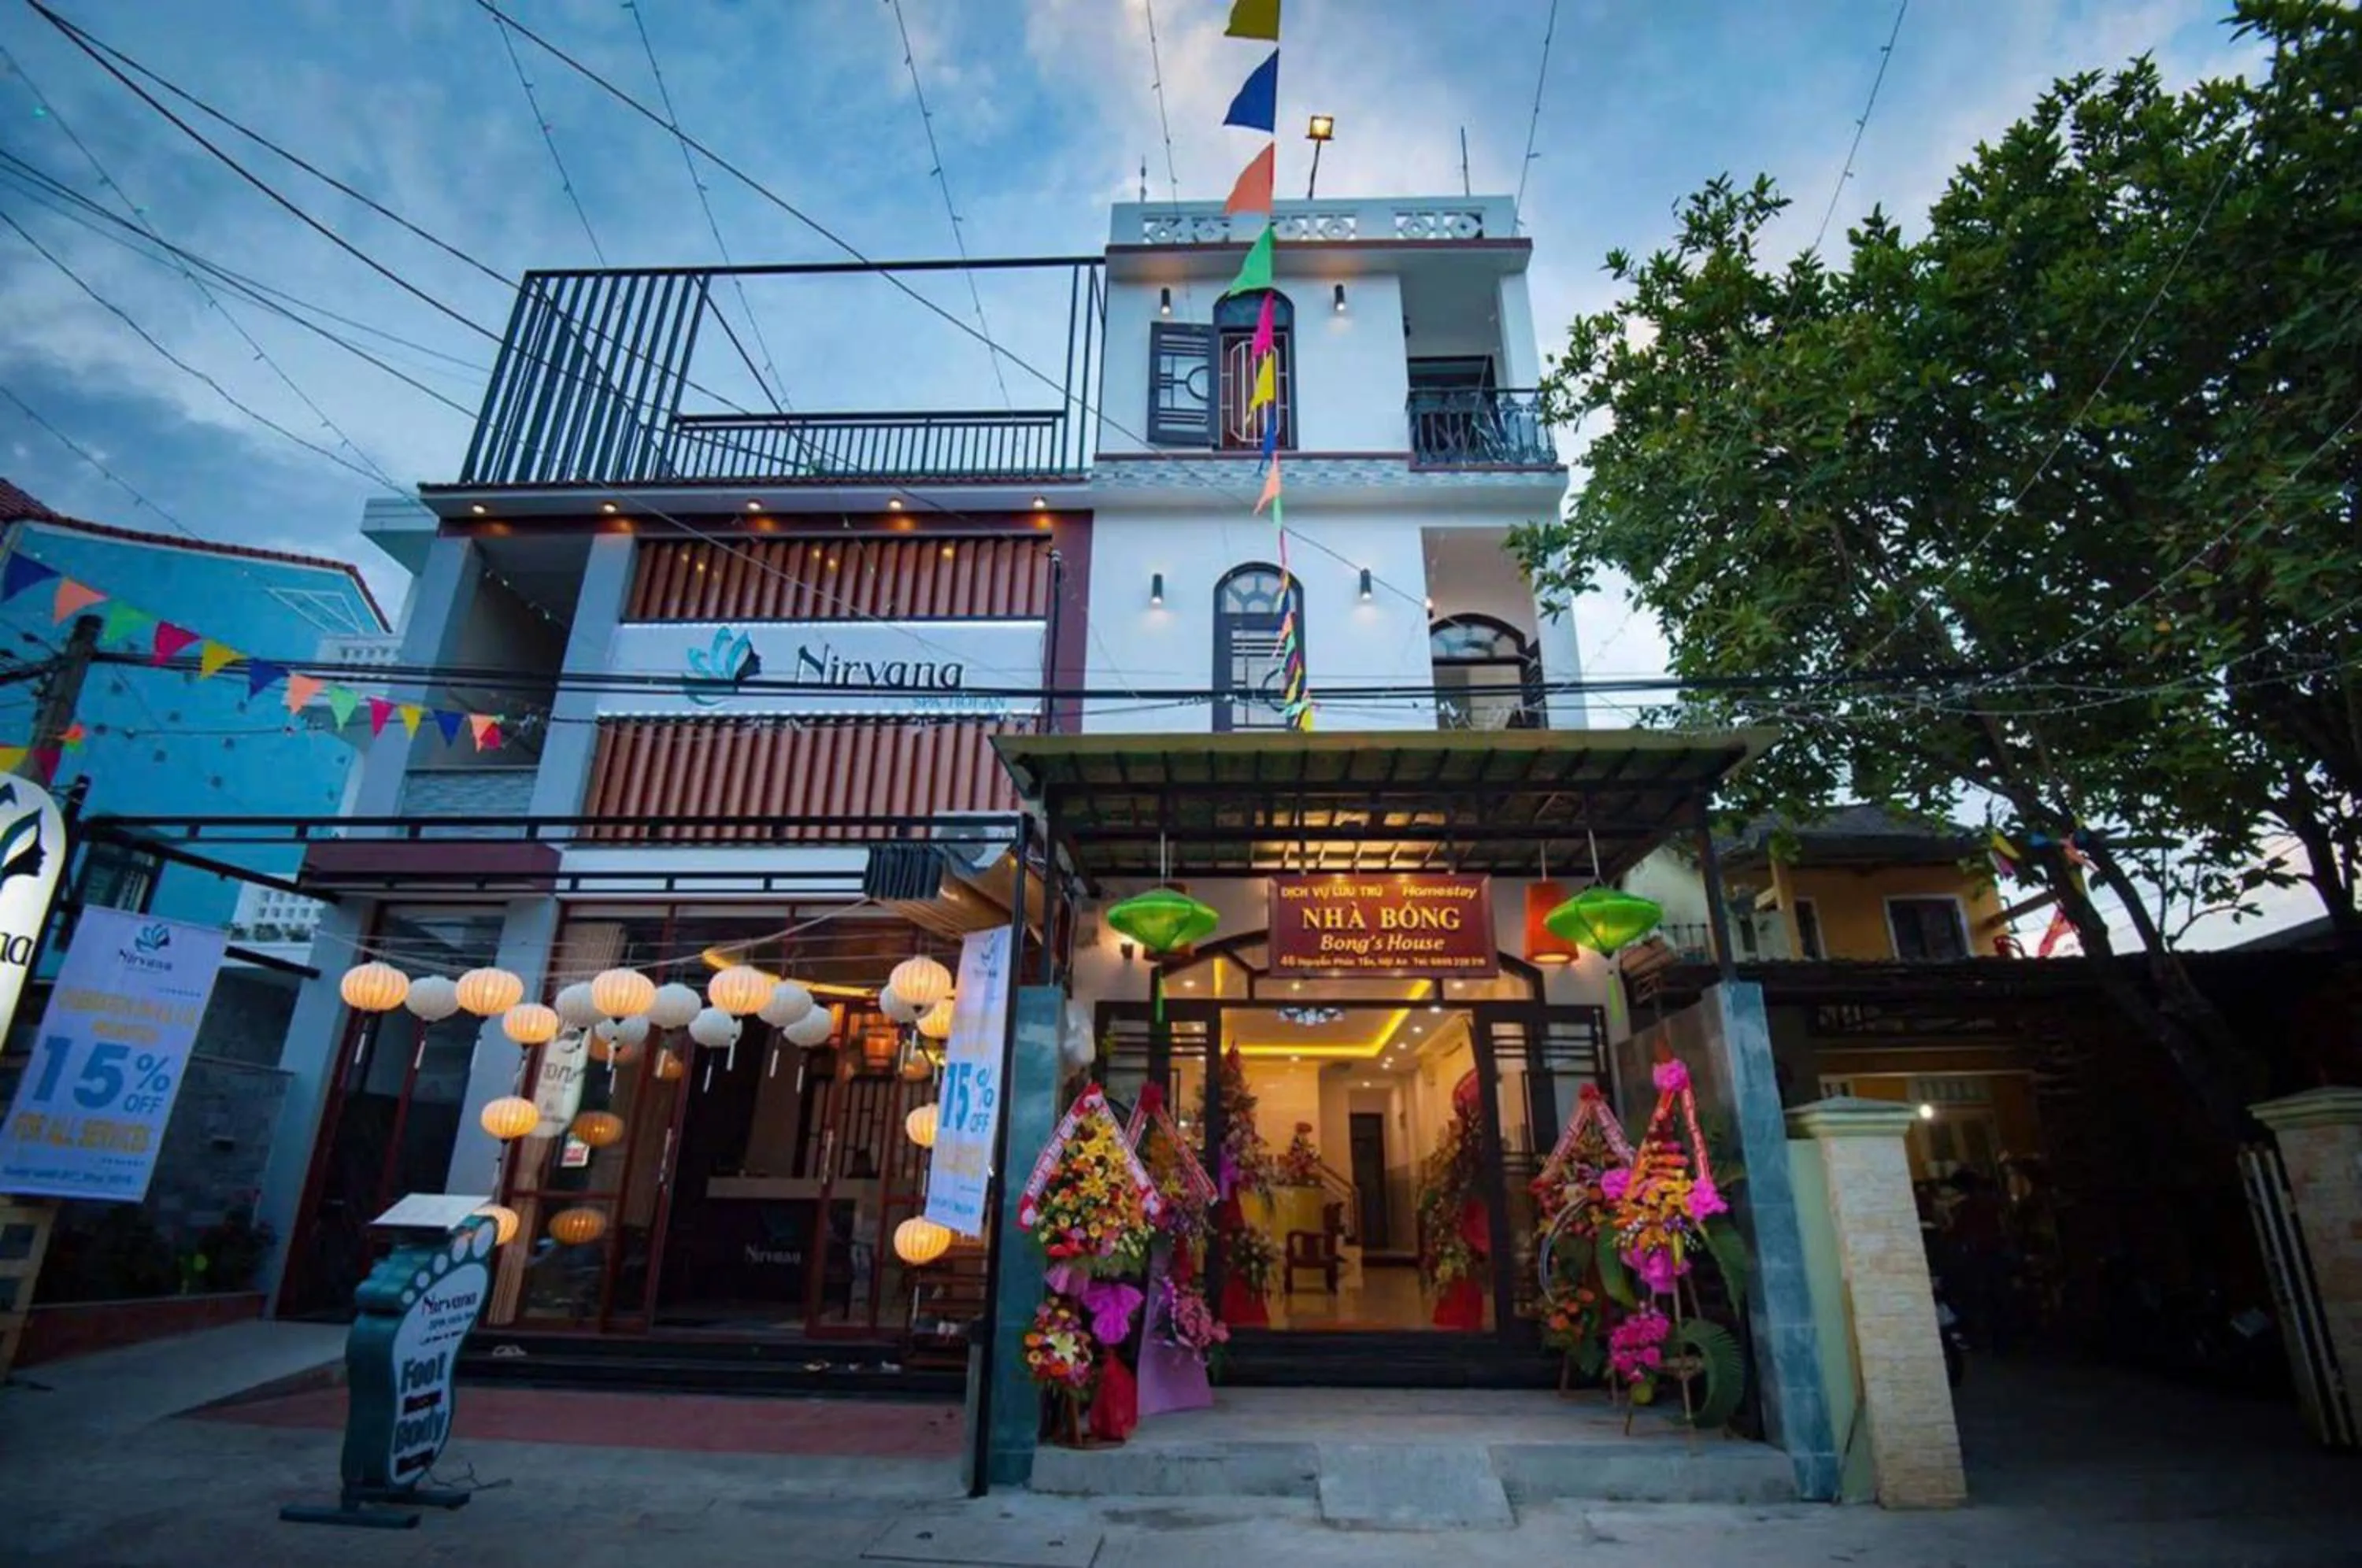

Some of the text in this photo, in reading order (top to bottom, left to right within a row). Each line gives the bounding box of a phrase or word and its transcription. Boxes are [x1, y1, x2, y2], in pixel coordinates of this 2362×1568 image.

[795, 643, 964, 690] Nirvana
[1401, 883, 1478, 900] Homestay
[1301, 901, 1367, 930] NHÀ
[1320, 934, 1446, 955] Bong's House
[123, 1093, 164, 1115] OFF
[400, 1352, 446, 1395] Foot
